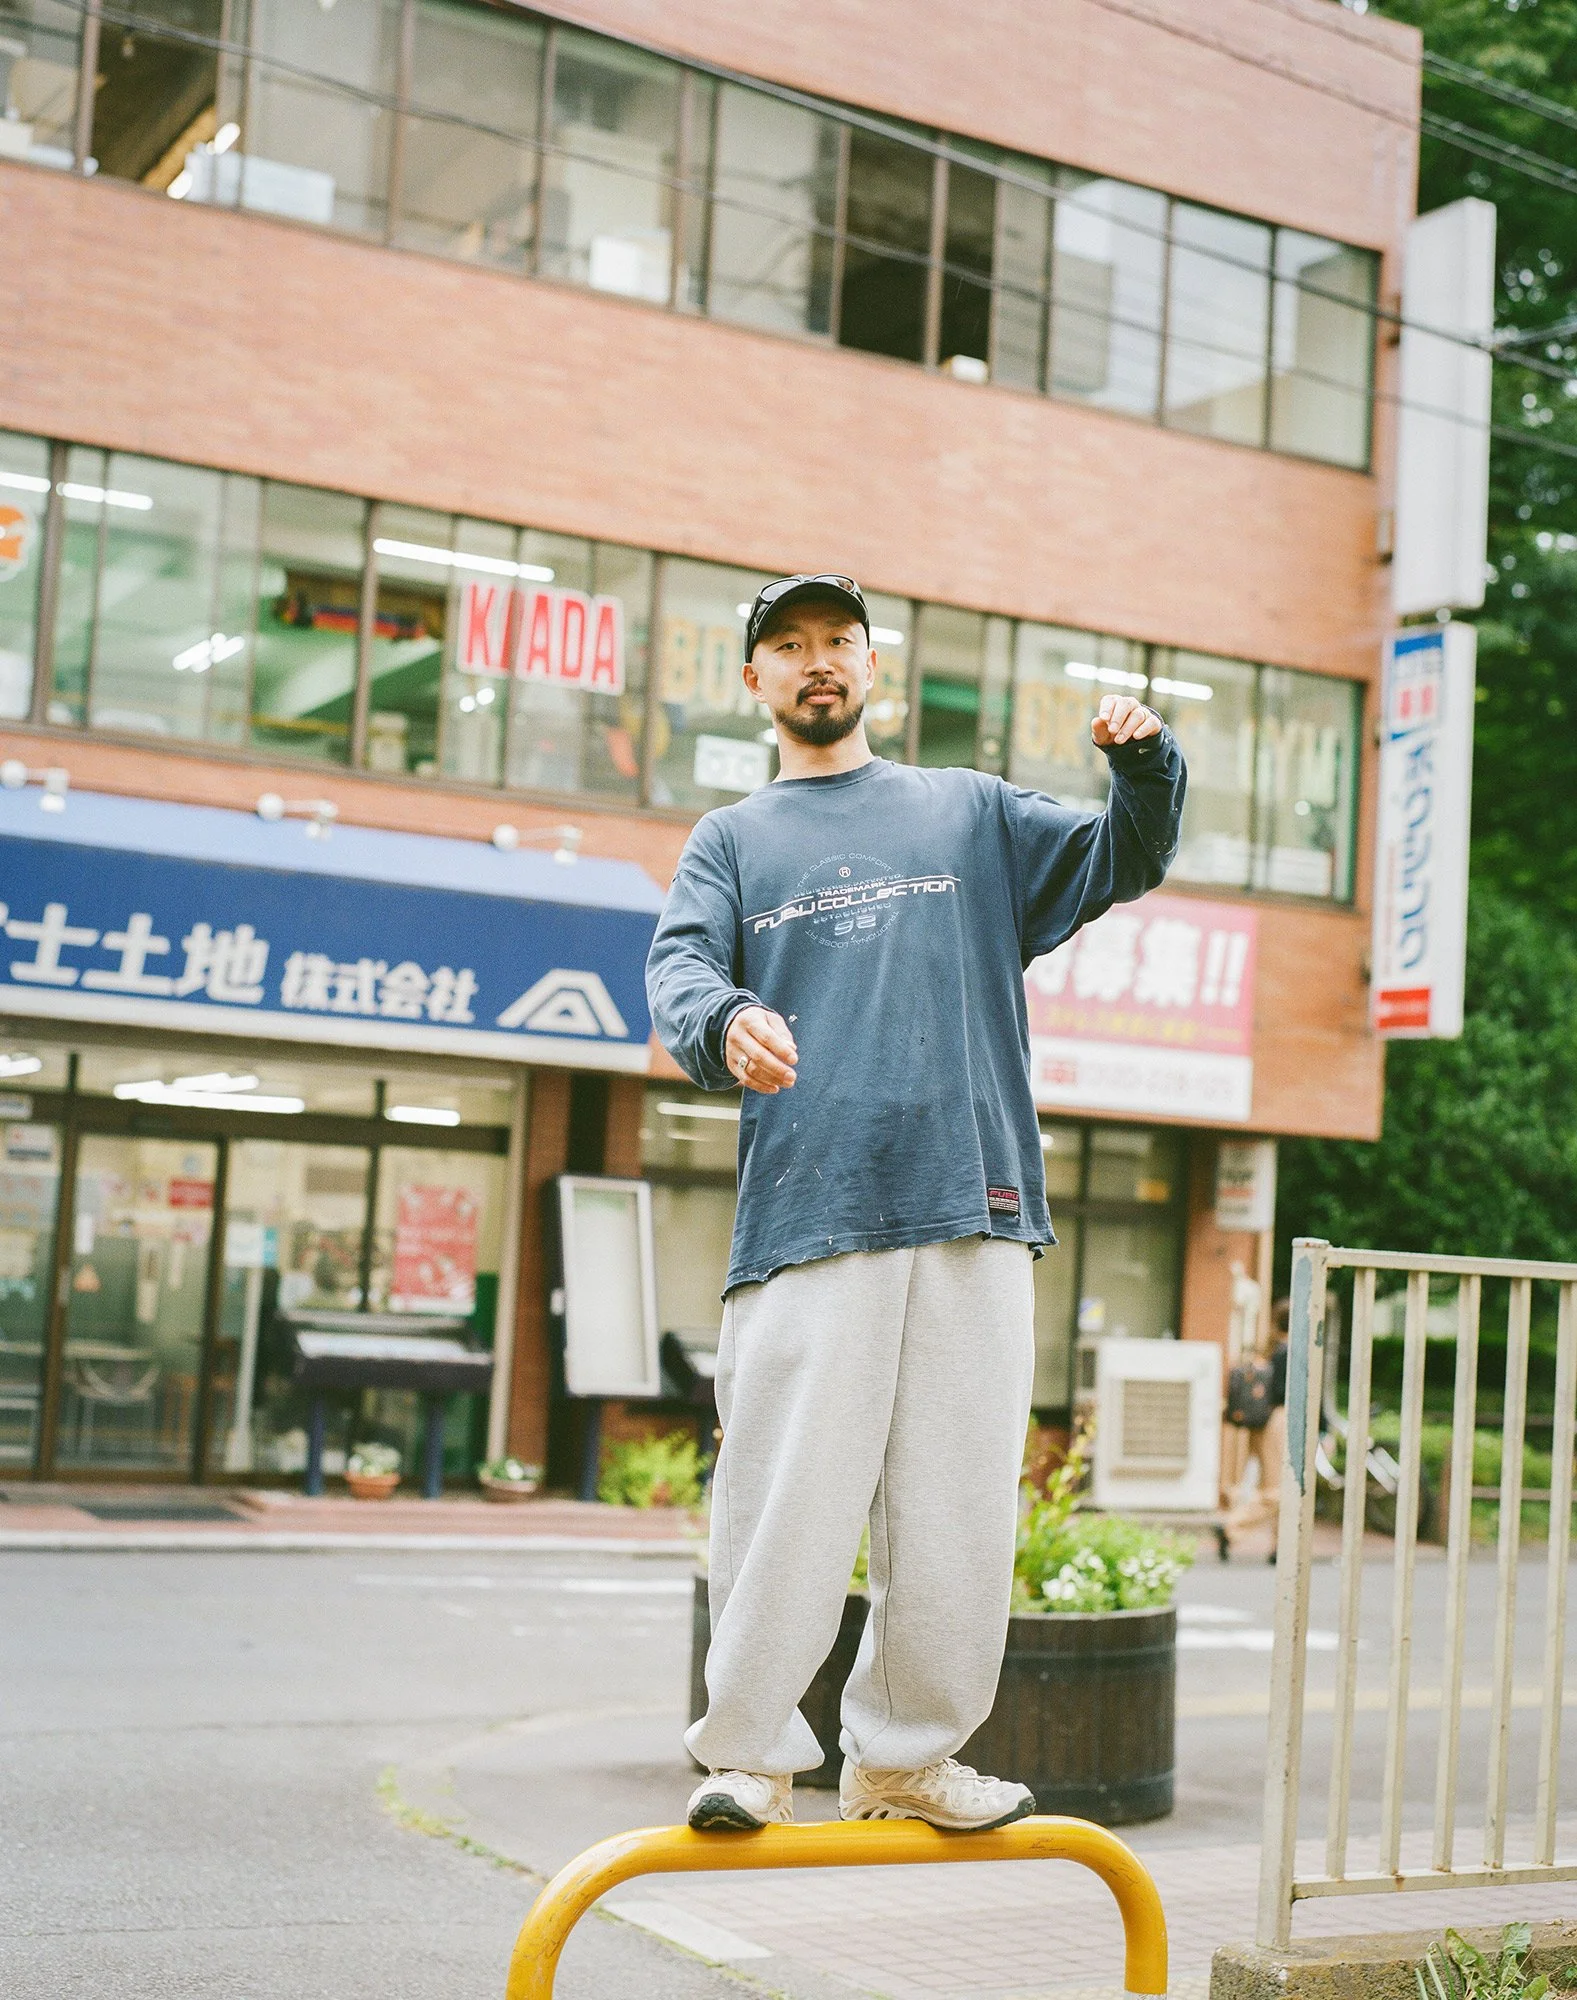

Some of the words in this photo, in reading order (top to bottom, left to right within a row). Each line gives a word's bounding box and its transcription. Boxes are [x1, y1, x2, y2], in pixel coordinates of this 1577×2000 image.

[796, 871, 811, 888] THE
[809, 853, 846, 871] CLASSIC
[848, 853, 894, 872] COMFORT
[818, 881, 886, 898] TRADEMARK
[753, 902, 816, 935] FUBU
[817, 880, 956, 911] COLLECTION
[813, 902, 892, 924] ESTABLISHED
[804, 929, 819, 941] FIT
[851, 911, 900, 945] TRADITIONAL
[819, 938, 849, 949] LOOSE
[0, 901, 271, 1004] 士土地
[280, 951, 479, 1024] 株式会社
[989, 1190, 1019, 1200] FUBU
